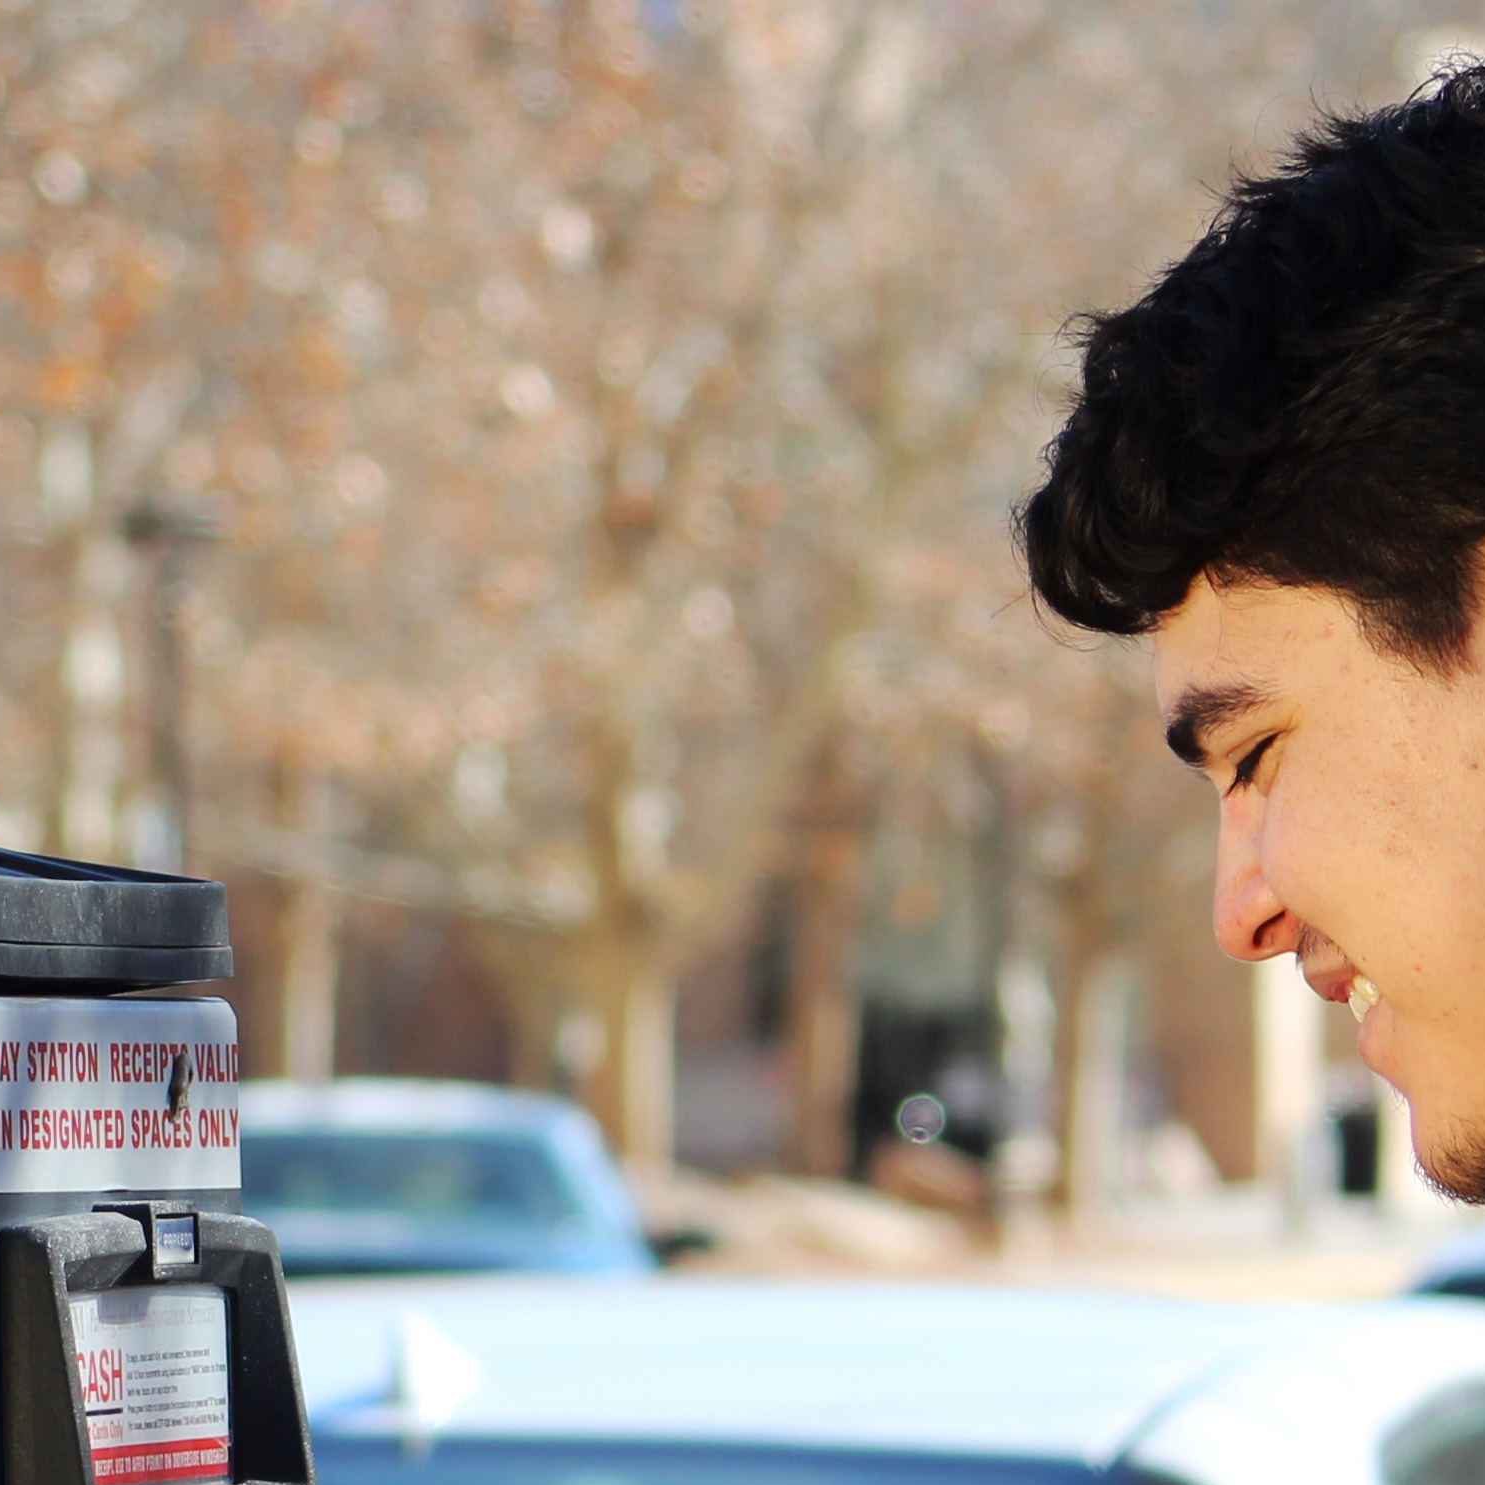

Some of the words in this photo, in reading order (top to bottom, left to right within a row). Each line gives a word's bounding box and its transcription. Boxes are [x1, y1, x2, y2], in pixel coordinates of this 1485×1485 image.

[27, 1042, 99, 1082] STATION
[110, 1043, 190, 1083] RECEIP
[19, 1109, 125, 1150] DESIGNATED
[131, 1109, 192, 1149] SPACES
[198, 1109, 238, 1148] ONLY
[75, 1348, 123, 1403] CASH
